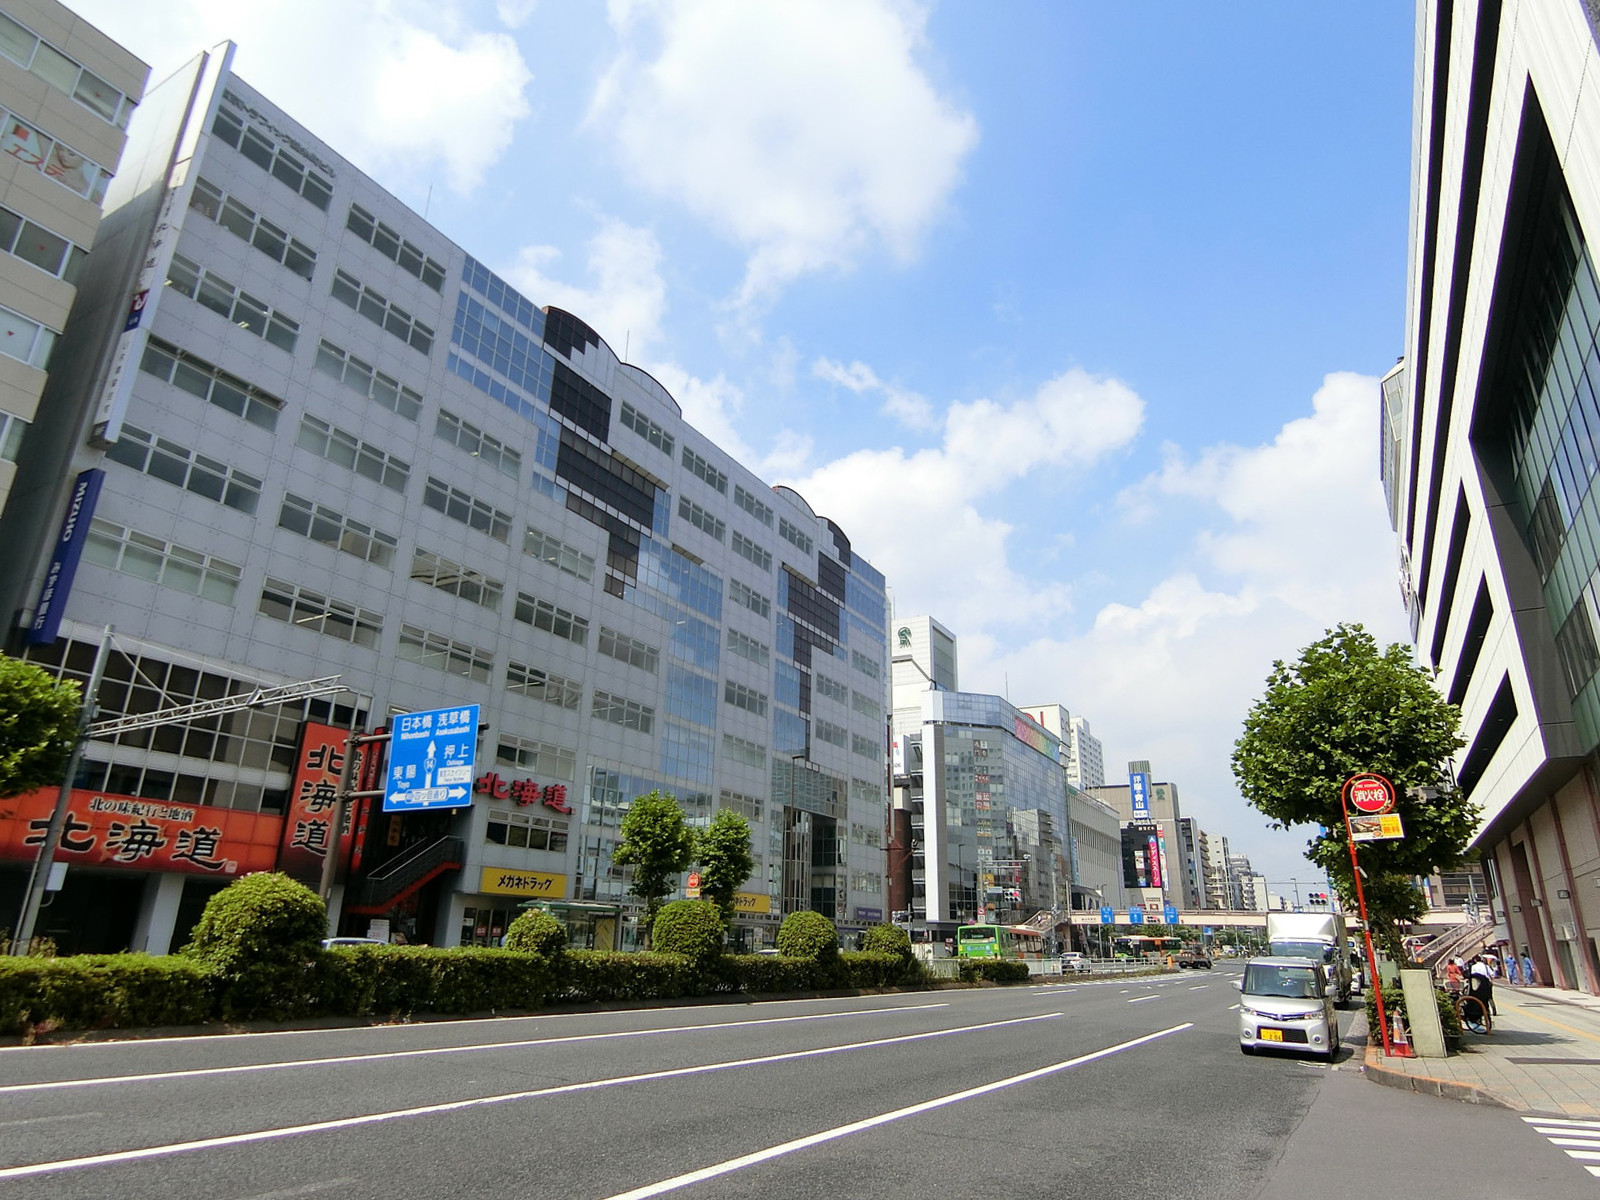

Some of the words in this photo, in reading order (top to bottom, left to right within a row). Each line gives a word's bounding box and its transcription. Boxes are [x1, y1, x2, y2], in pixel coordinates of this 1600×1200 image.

[62, 481, 88, 543] MIZUHO
[401, 715, 432, 732] 日本橋
[437, 709, 470, 727] 浅草橋
[443, 743, 469, 759] 押上
[392, 764, 416, 780] 東陽
[426, 760, 433, 768] 14
[397, 781, 410, 790] Toyo
[477, 772, 571, 813] 北海道
[290, 743, 344, 857] 北海道
[1354, 789, 1385, 802] 消火栓
[89, 798, 194, 822] 北の味紀行と地酒
[24, 811, 227, 871] 北海道
[497, 874, 554, 890] メガネドラッグ
